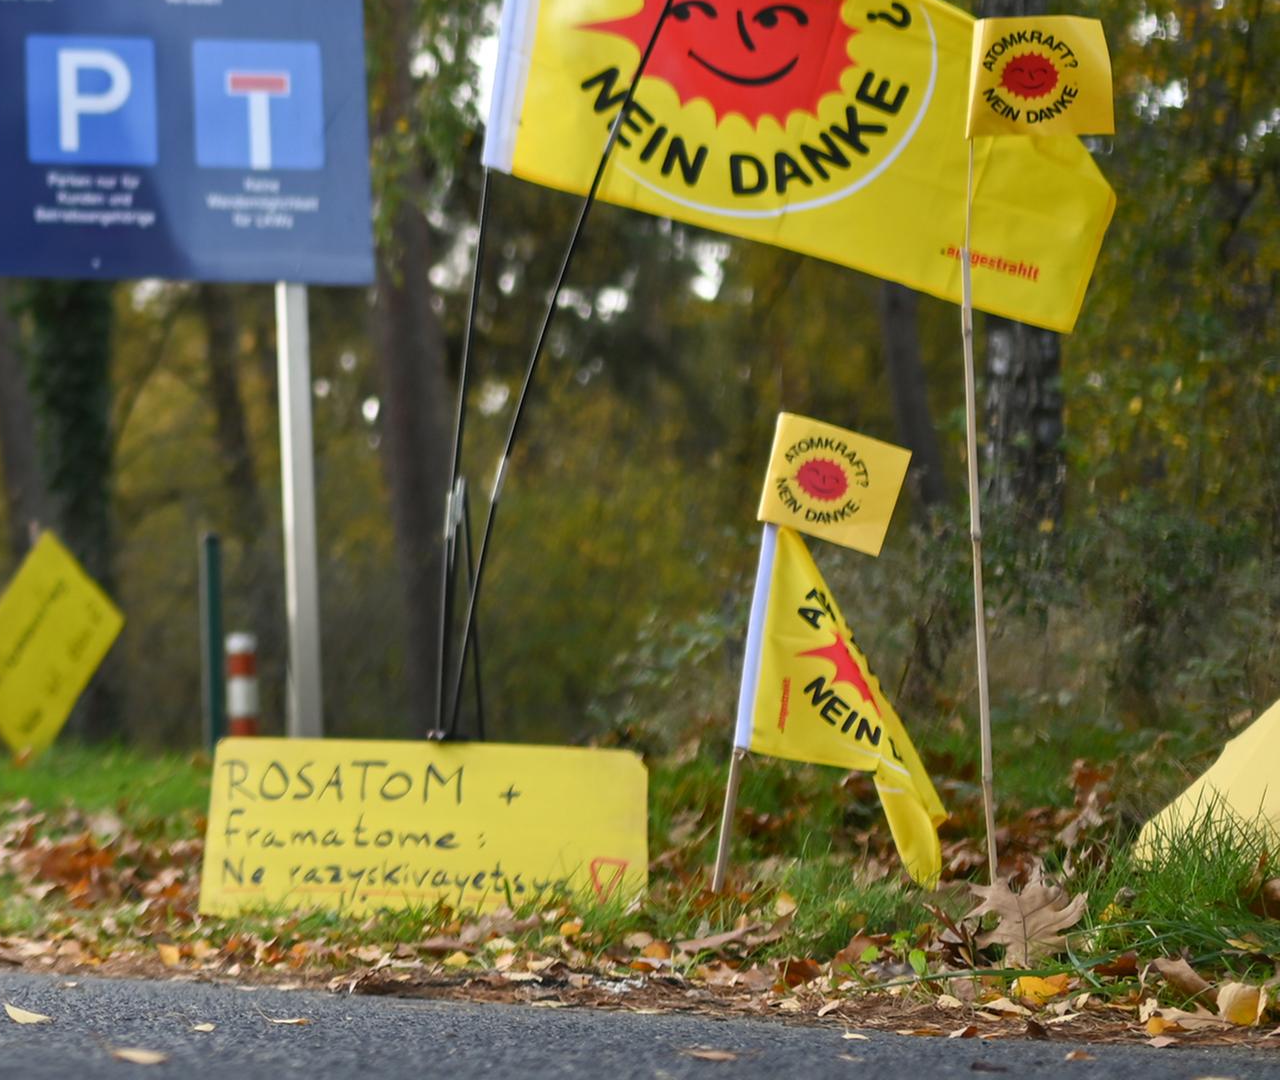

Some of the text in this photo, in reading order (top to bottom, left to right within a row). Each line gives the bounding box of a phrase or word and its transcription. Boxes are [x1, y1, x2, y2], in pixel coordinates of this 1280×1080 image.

[982, 29, 1079, 73] ATOMKRAFT?
[58, 49, 132, 153] P
[982, 84, 1079, 124] NEIN DANKE
[581, 67, 910, 197] NEIN DANKE
[785, 438, 869, 488] ATOMKRAFT?
[776, 478, 860, 524] NEIN DANKE
[803, 676, 882, 746] NEIN
[222, 859, 266, 886] Ne
